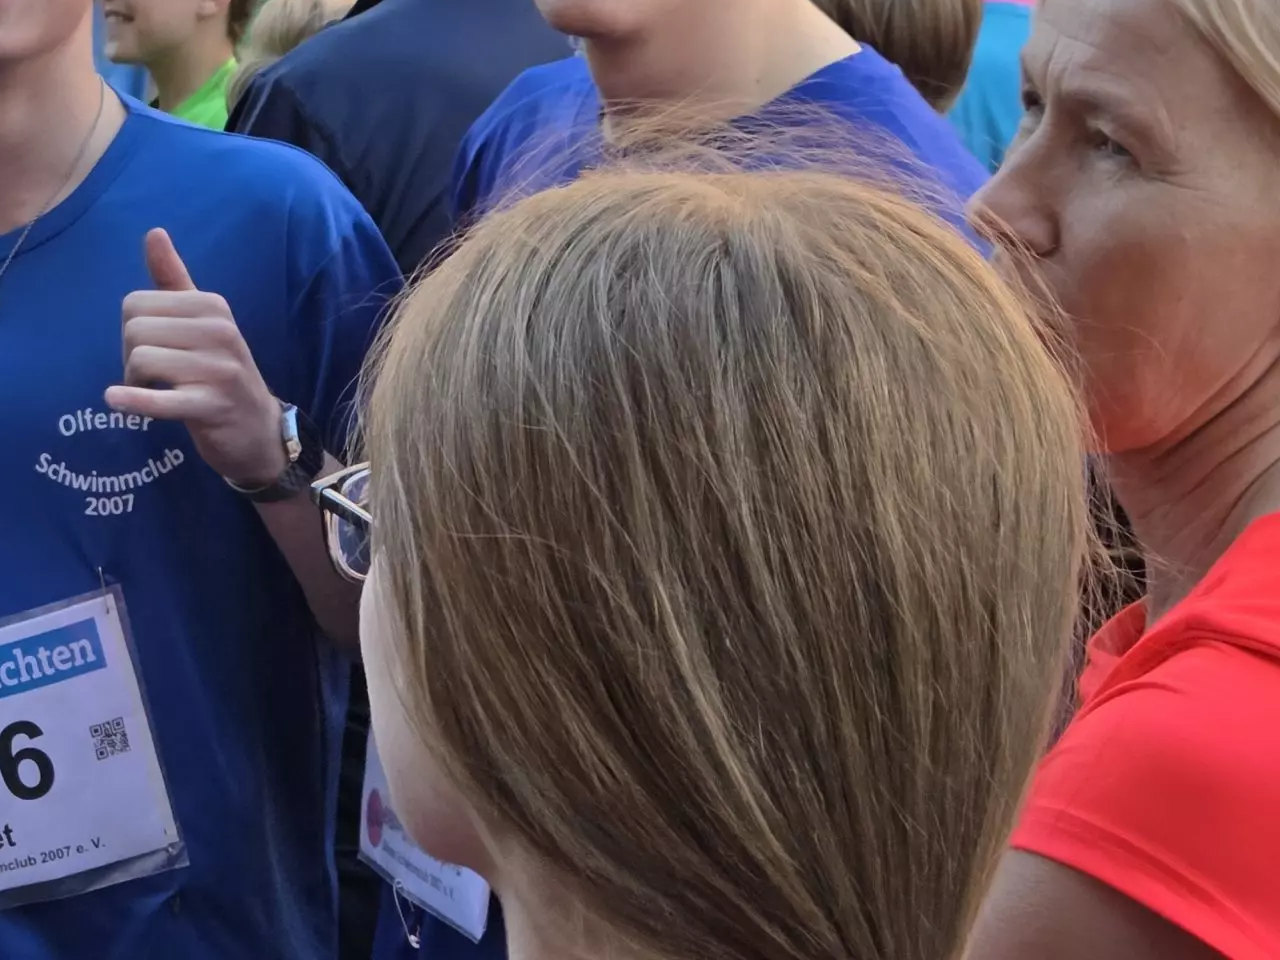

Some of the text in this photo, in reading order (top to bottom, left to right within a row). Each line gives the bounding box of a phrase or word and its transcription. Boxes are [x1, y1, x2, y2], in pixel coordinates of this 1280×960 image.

[58, 407, 154, 437] Olfener
[35, 446, 184, 494] Schwimmclub
[84, 494, 135, 517] 2007
[40, 845, 71, 864] 2007
[91, 836, 106, 849] V.
